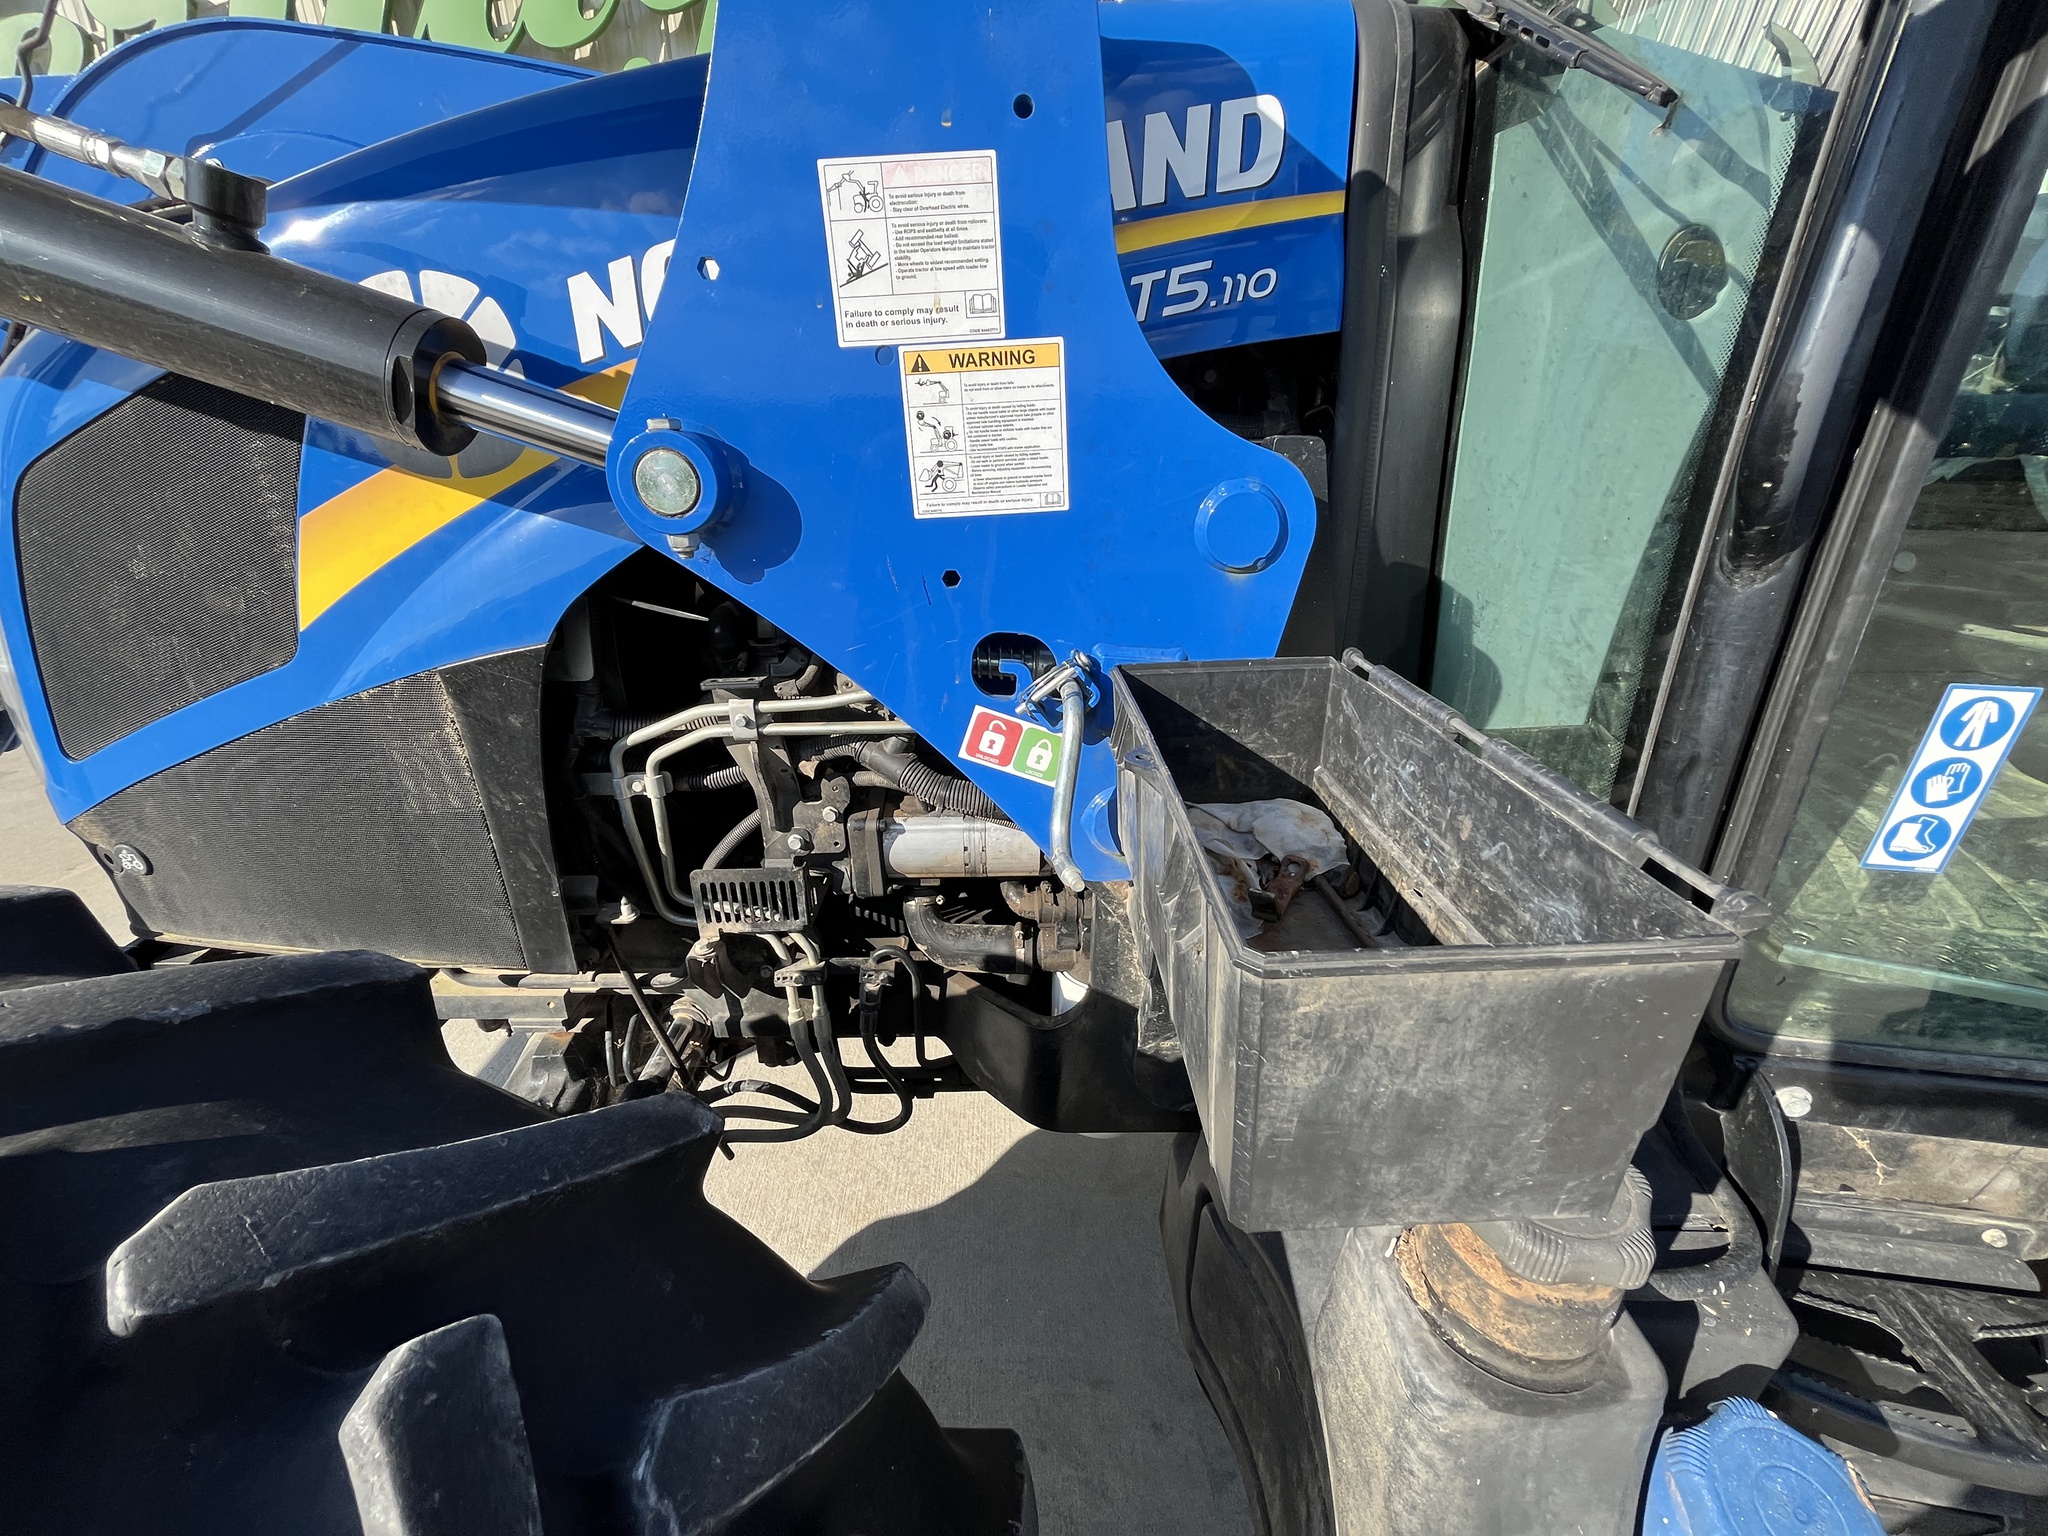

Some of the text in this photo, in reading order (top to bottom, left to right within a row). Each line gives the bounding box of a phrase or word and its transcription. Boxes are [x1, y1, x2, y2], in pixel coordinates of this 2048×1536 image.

[1130, 260, 1277, 322] T5.110
[844, 304, 959, 318] Failure to comply may result
[845, 321, 853, 329] in
[855, 319, 878, 328] death
[890, 317, 921, 326] serious
[923, 316, 948, 326] injury.
[948, 349, 1036, 369] WARNING
